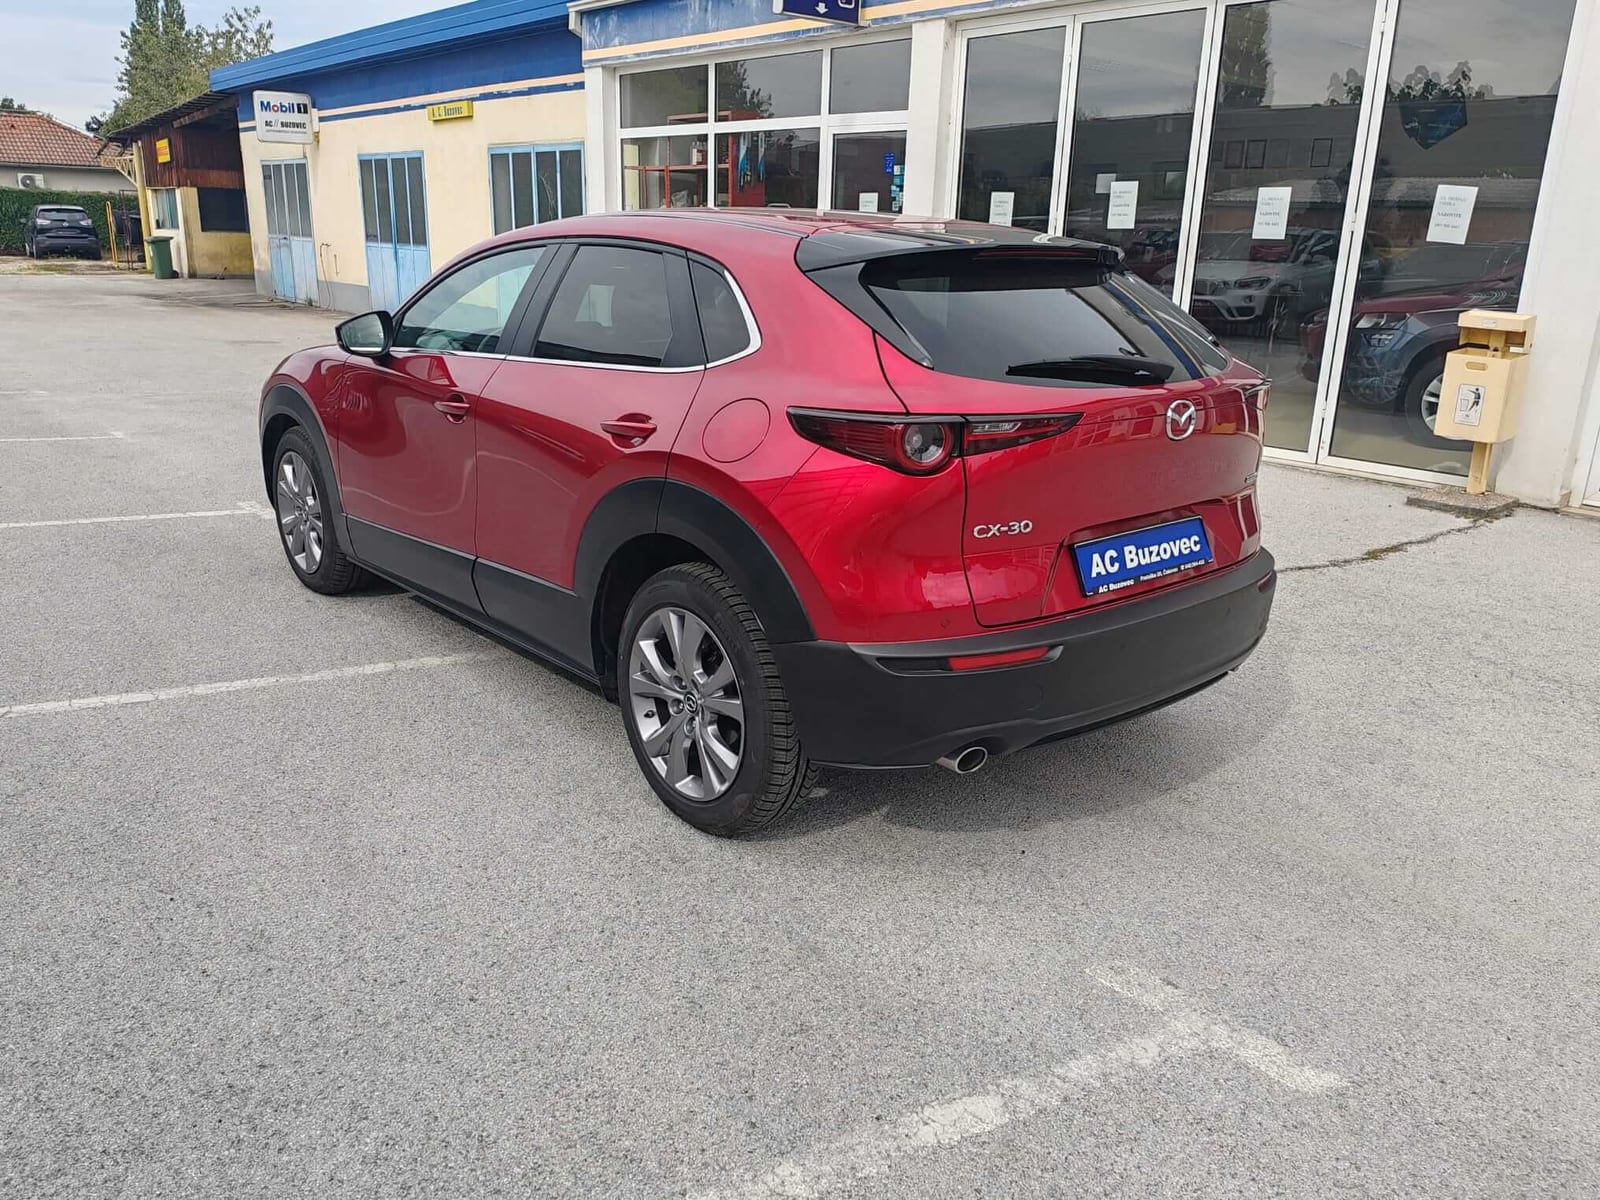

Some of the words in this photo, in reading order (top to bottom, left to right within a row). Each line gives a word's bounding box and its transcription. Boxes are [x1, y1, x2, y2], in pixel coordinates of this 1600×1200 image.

[260, 100, 295, 113] Mobil
[265, 120, 273, 128] AC
[280, 121, 306, 129] BUZOVEC
[973, 519, 1033, 538] CX-30
[1091, 549, 1119, 578] AC
[1123, 535, 1201, 569] Buzovec
[1099, 585, 1109, 593] AC
[1109, 579, 1134, 591] Buzovec
